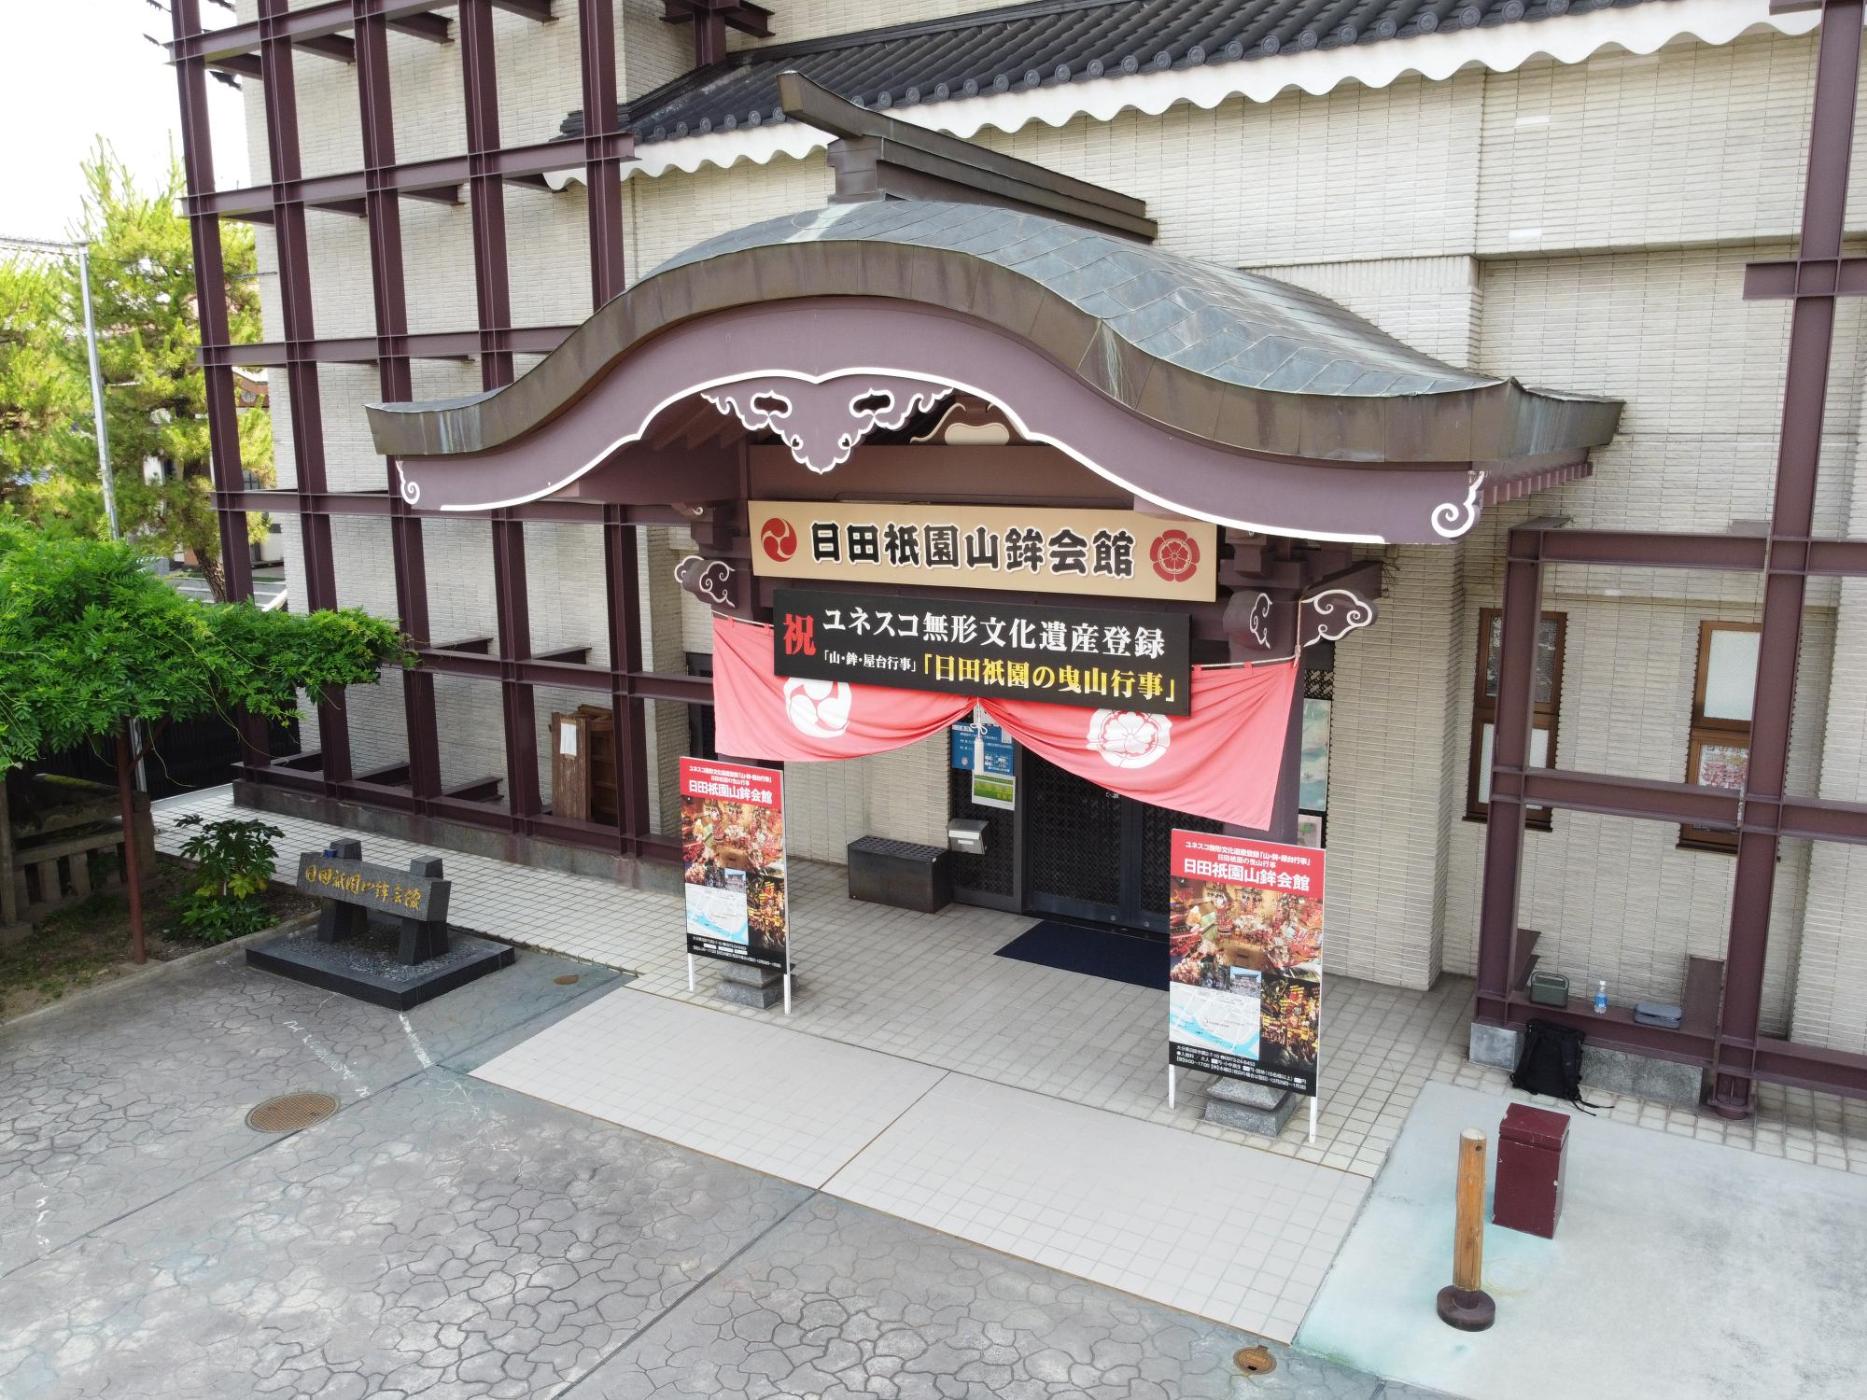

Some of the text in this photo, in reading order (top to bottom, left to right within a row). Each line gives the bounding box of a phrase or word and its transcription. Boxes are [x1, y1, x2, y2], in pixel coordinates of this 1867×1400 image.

[811, 522, 1134, 577] 日田祇園山鉾会館
[783, 613, 817, 656] 祝
[822, 607, 1166, 660] ユネスコ無形文化遺産登録
[924, 653, 1176, 703] 「日田祇園の曳山行事」
[688, 780, 773, 805] 日田祇園山鉾会館
[1184, 858, 1311, 892] 日田祇園山鉾会館
